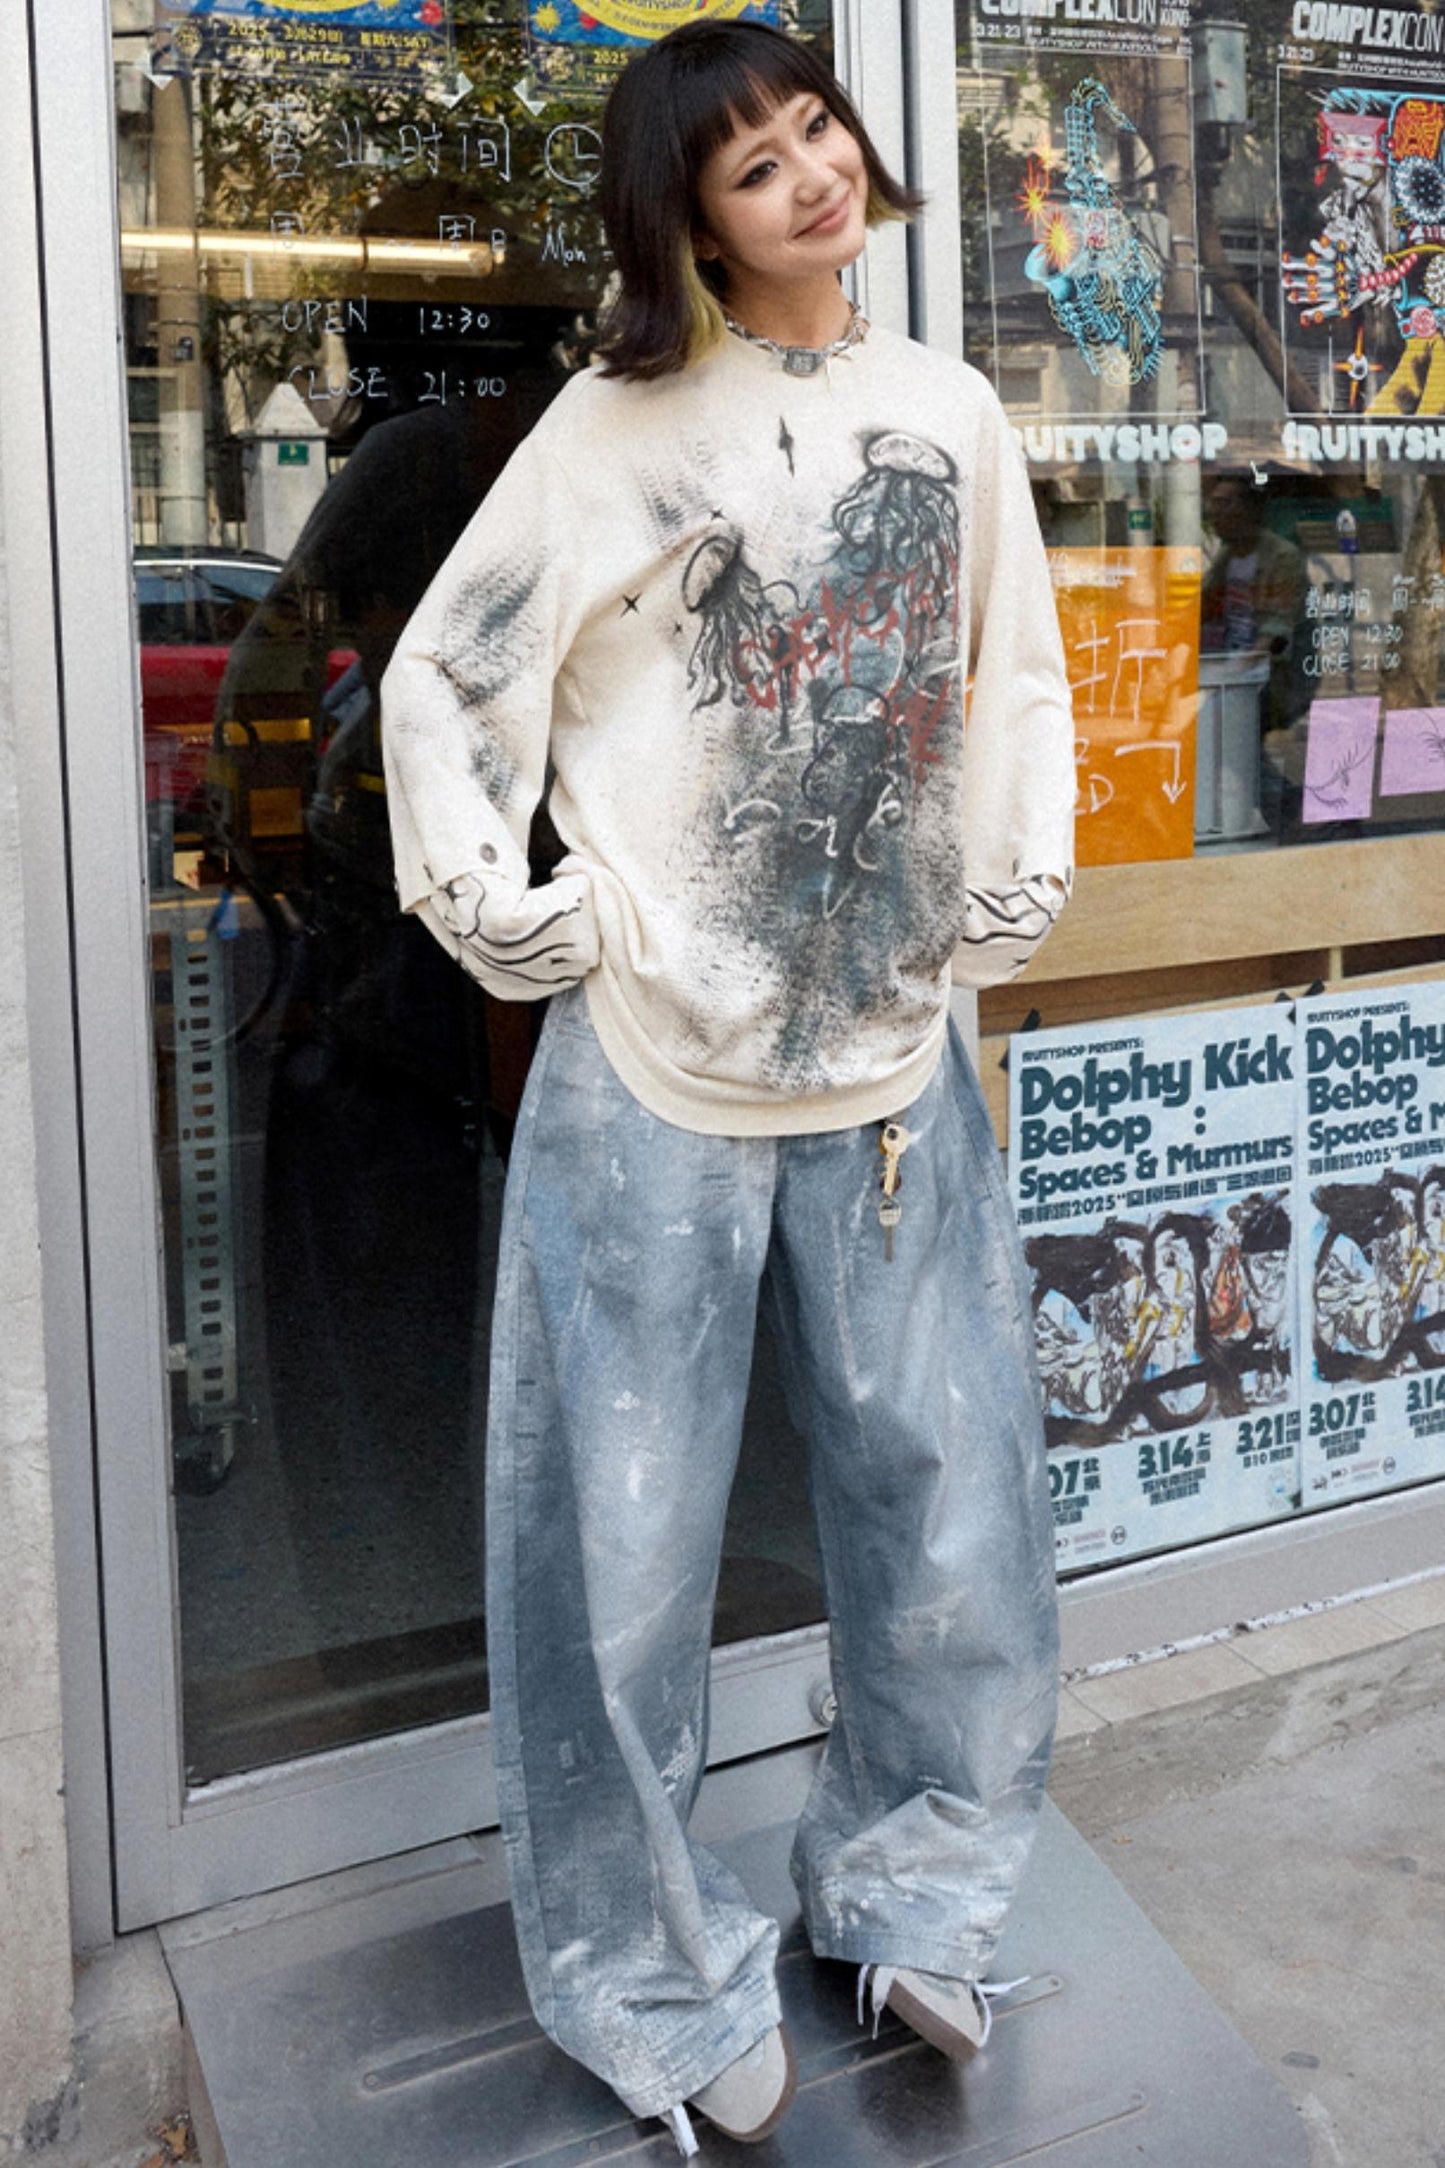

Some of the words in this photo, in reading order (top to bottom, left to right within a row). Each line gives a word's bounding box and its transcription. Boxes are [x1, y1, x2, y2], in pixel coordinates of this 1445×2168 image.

[1292, 0, 1443, 52] COMPLEXCON
[282, 294, 368, 334] OPEN
[419, 306, 492, 336] 12:30
[417, 368, 508, 406] 21:00
[1305, 1014, 1445, 1075] Dolphy
[1020, 1052, 1192, 1118] Dolphy
[1203, 1034, 1294, 1091] Kick
[1307, 1069, 1418, 1116] Bebop
[1020, 1111, 1152, 1162] Bebop
[1307, 1116, 1399, 1155] Spaces
[1404, 1105, 1422, 1134] &
[1019, 1160, 1127, 1202] Spaces
[1135, 1149, 1158, 1181] &
[1166, 1135, 1293, 1176] Murmurs
